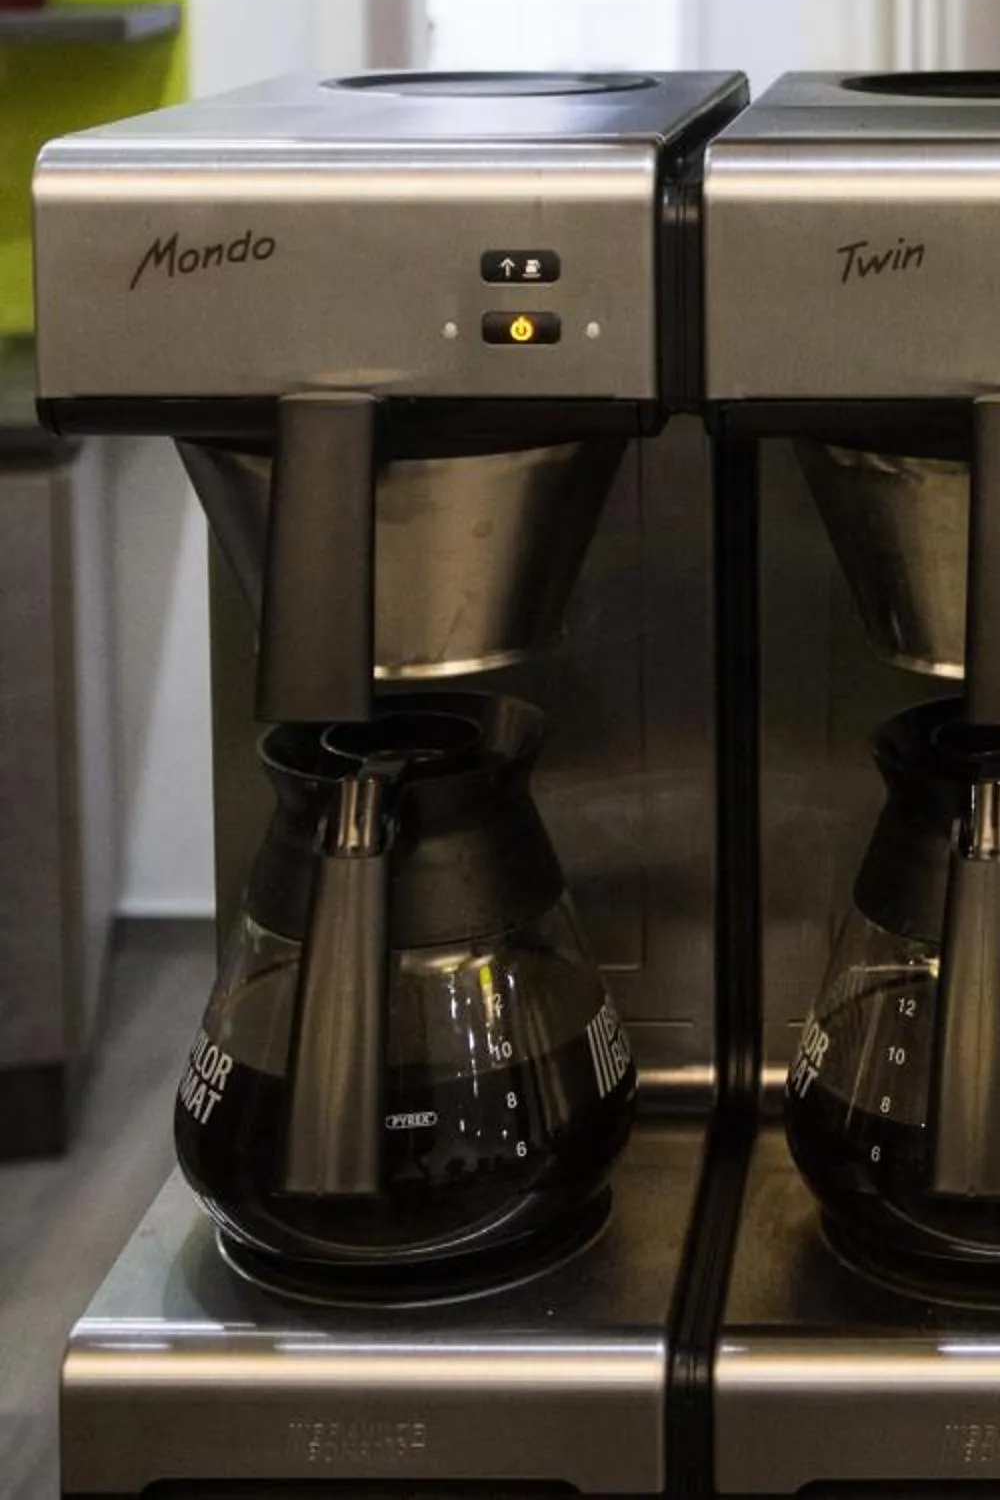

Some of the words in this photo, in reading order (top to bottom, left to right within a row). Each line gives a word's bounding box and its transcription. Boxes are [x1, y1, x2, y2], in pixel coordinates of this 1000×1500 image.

[129, 231, 276, 291] Mondo
[836, 238, 925, 284] Twin
[899, 997, 916, 1017] 12
[888, 1046, 905, 1065] 10
[506, 1091, 517, 1108] 8
[880, 1096, 891, 1113] 8
[391, 1112, 433, 1127] PYREX
[516, 1141, 527, 1157] 6
[871, 1145, 881, 1162] 6
